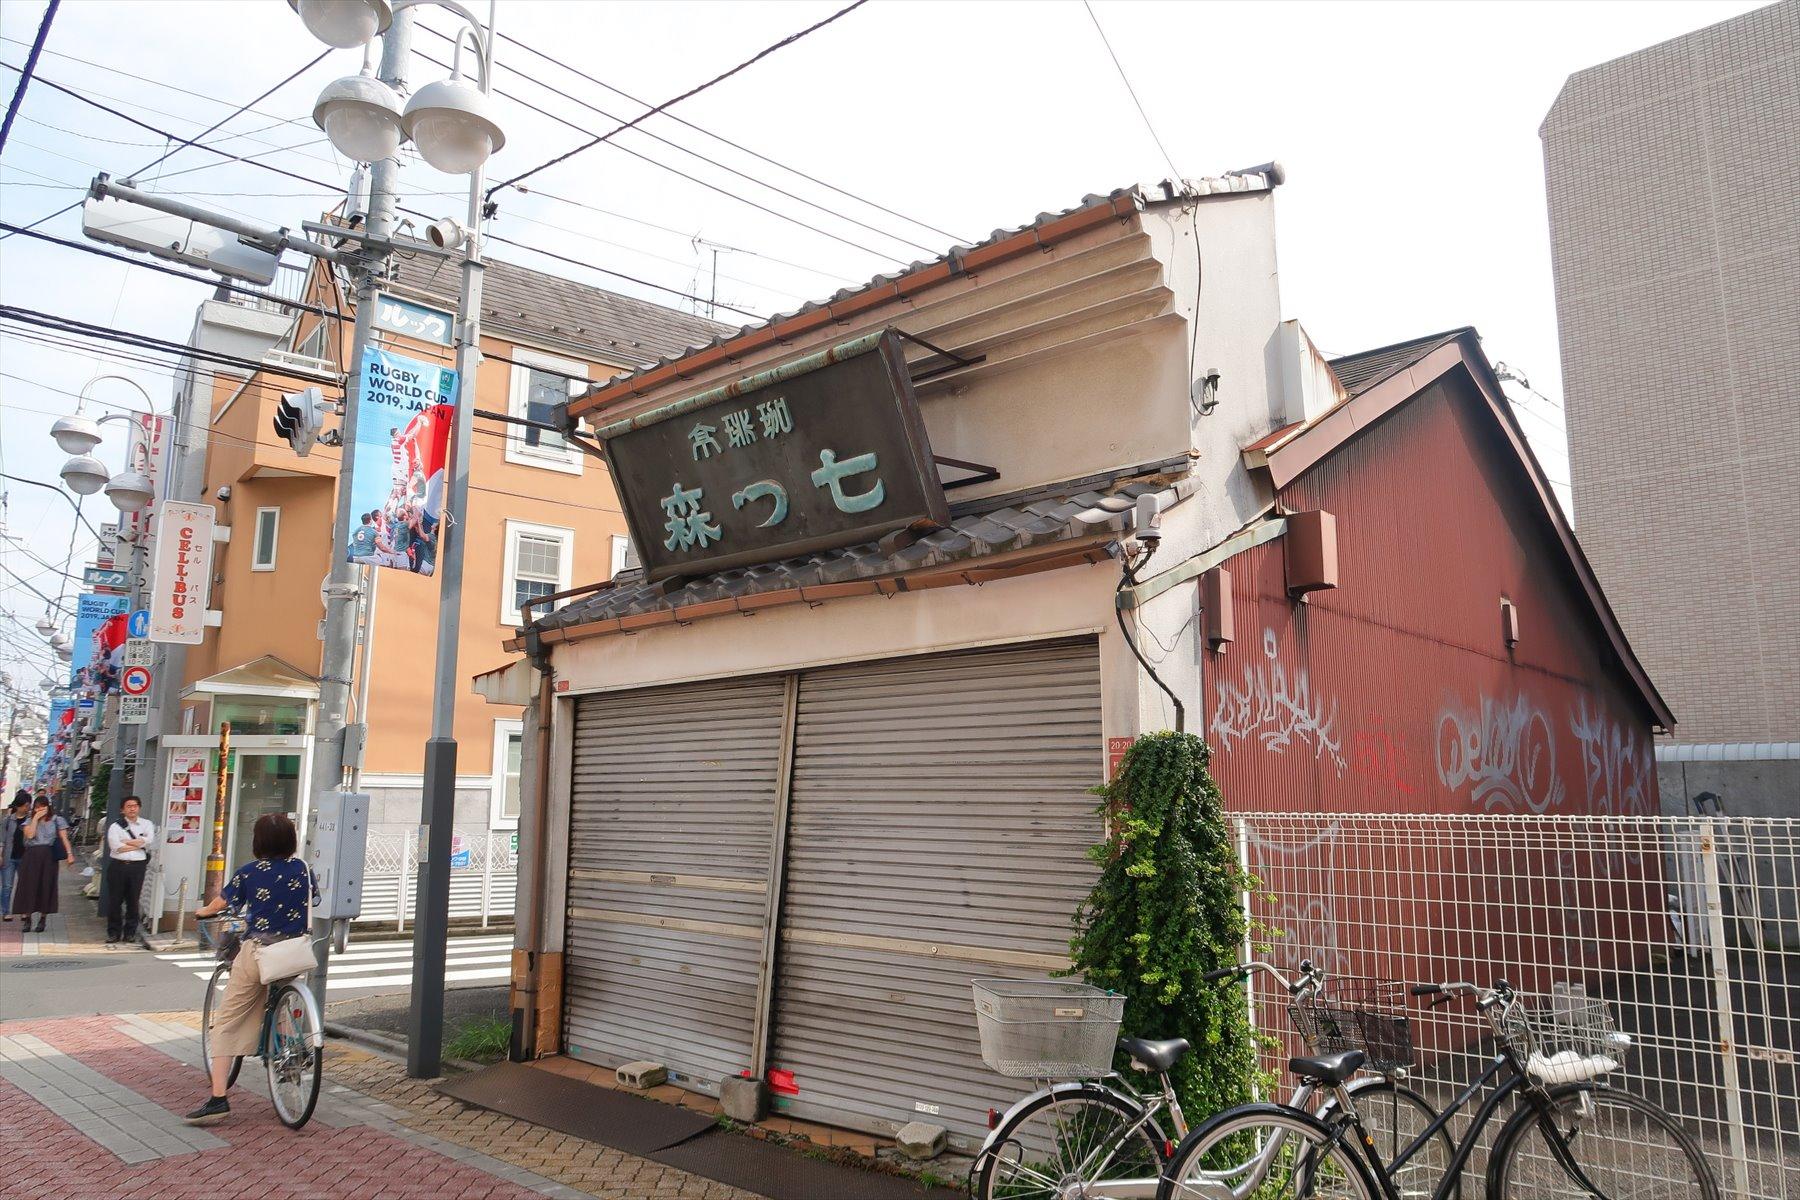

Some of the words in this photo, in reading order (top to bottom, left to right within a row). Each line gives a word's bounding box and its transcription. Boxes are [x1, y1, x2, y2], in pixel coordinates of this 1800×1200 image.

[381, 304, 446, 337] ルック
[370, 363, 419, 384] RUGBY
[367, 391, 404, 410] 2019,
[406, 400, 446, 419] JAPAN
[369, 377, 422, 398] WORLD
[425, 390, 448, 405] CUP
[1110, 741, 1120, 750] 20
